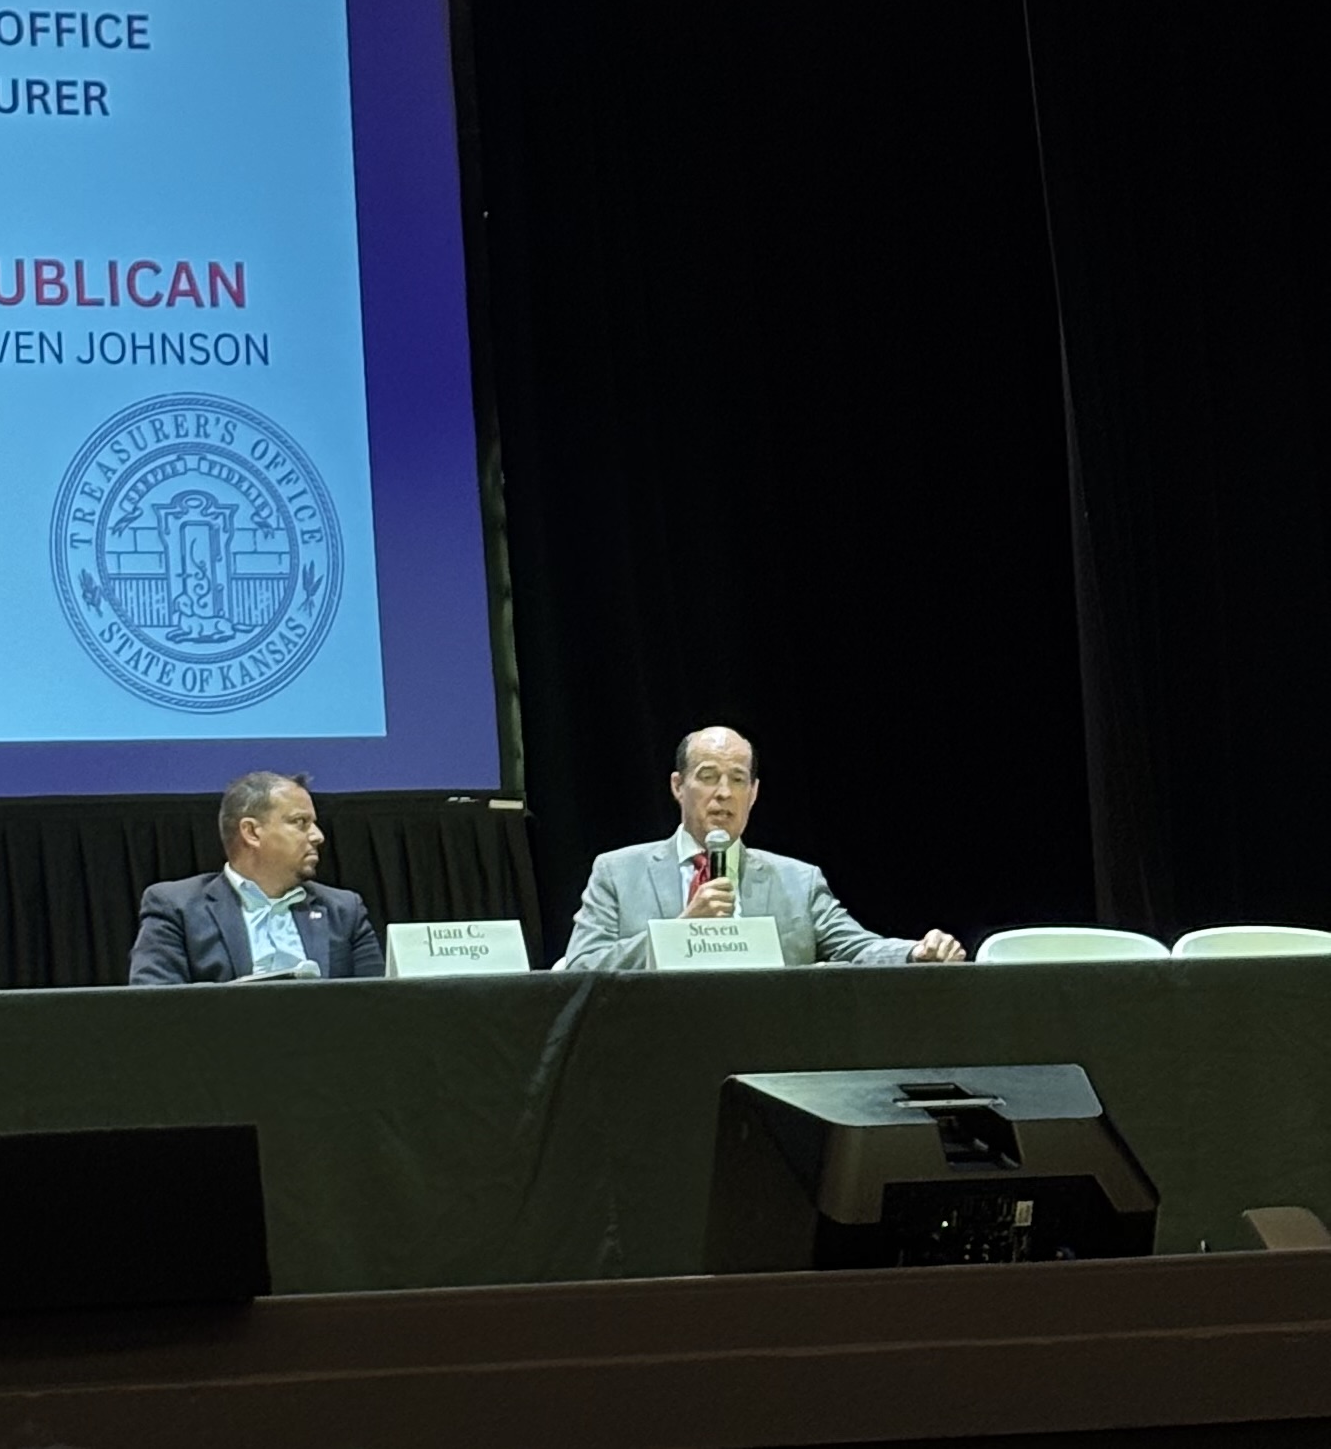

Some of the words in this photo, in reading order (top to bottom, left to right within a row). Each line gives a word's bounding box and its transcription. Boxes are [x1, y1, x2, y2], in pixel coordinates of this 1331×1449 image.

[75, 331, 270, 367] JOHNSON
[70, 413, 238, 549] TREASURER'S
[251, 438, 324, 546] OFFICE
[99, 621, 175, 685] STATE
[182, 668, 213, 693] OF
[218, 616, 308, 692] KANSAS
[423, 925, 463, 944] Juan
[467, 925, 485, 938] C.
[689, 922, 739, 936] Steven
[429, 939, 489, 960] Luengo
[685, 938, 748, 957] Johnson
